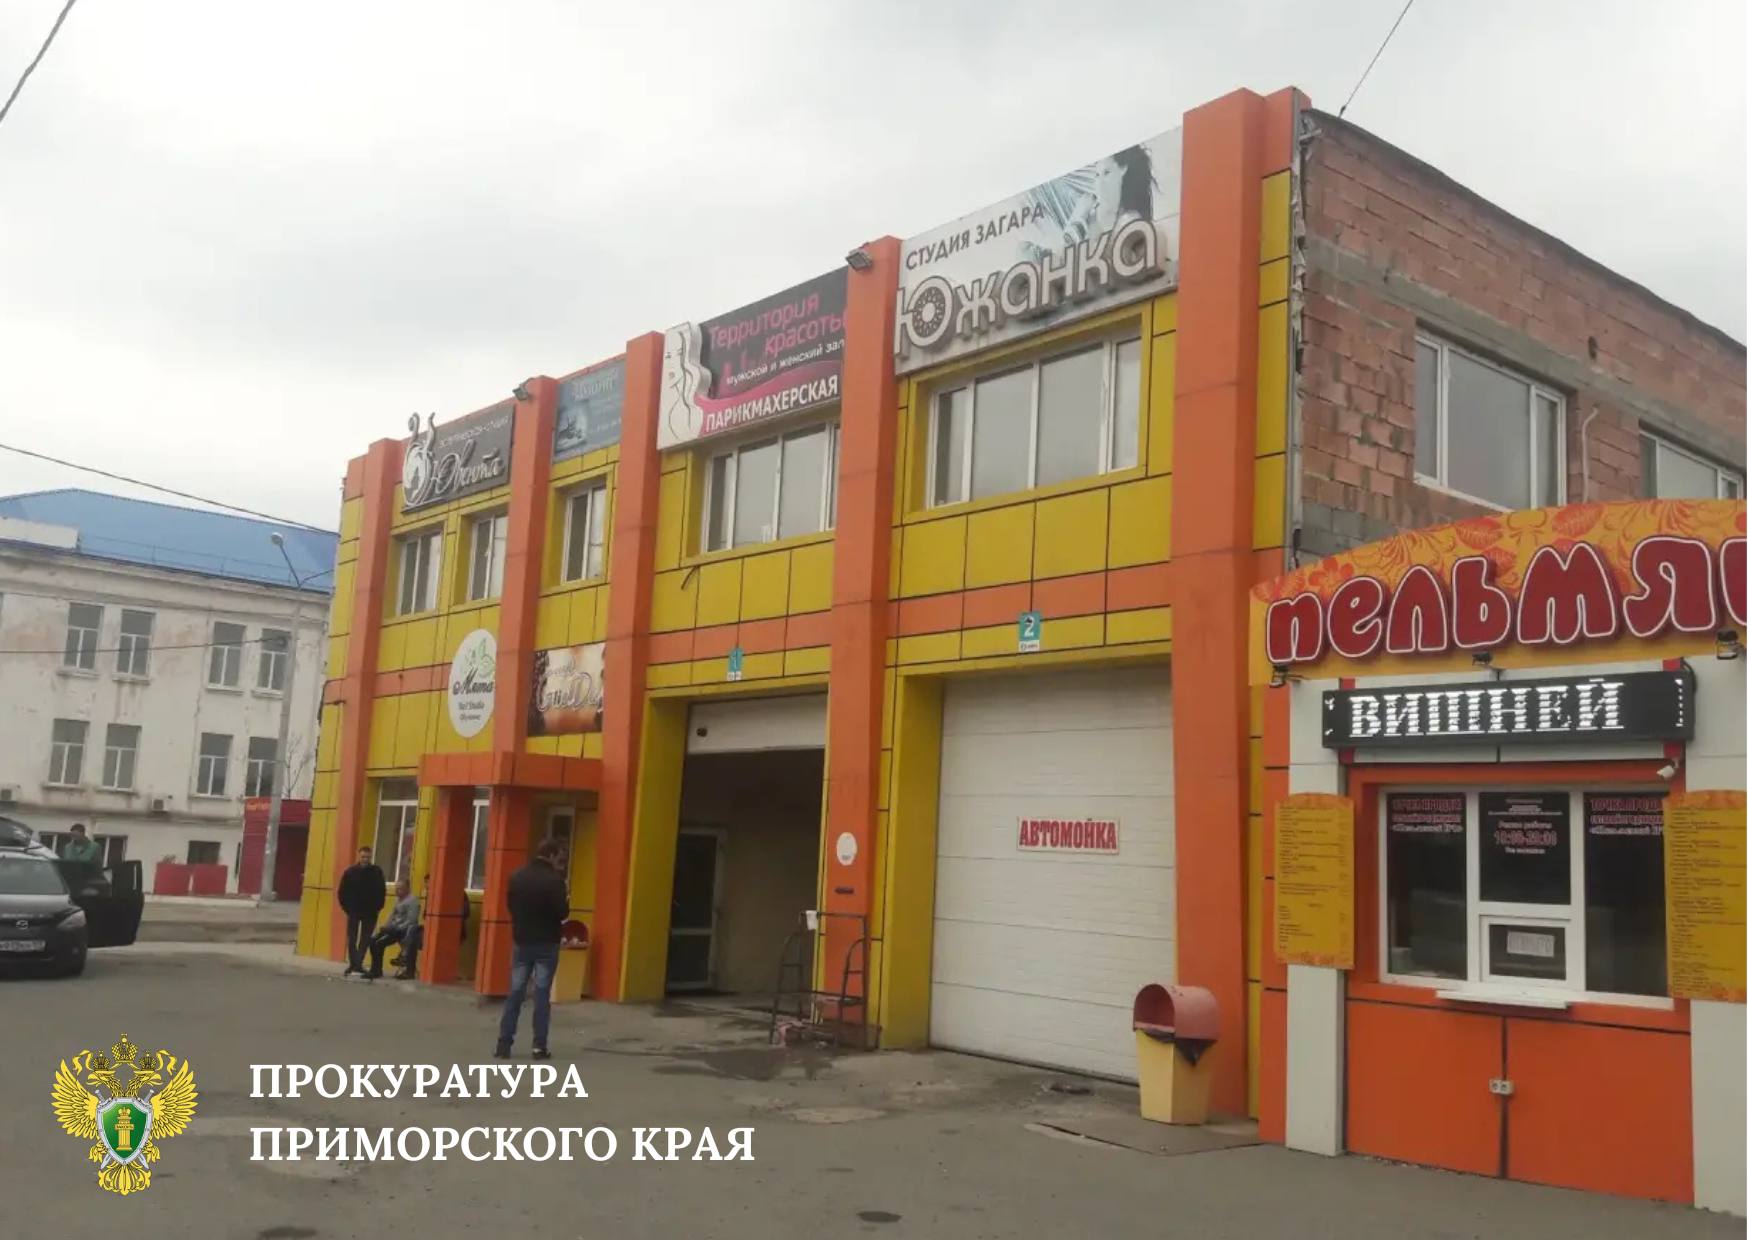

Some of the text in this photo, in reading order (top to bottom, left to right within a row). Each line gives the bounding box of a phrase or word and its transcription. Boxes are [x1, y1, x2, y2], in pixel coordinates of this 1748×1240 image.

[906, 201, 1044, 270] СТУДИЯ ЗАГАРА
[895, 216, 1163, 358] Южанка
[709, 293, 819, 350] Территория
[727, 365, 769, 386] мужской
[779, 343, 823, 368] женский
[705, 374, 839, 433] ПАРИКМАХЕРСКАЯ
[1348, 677, 1625, 739] ВИШНЕЙ
[1018, 817, 1118, 849] АВТОМОЙКА
